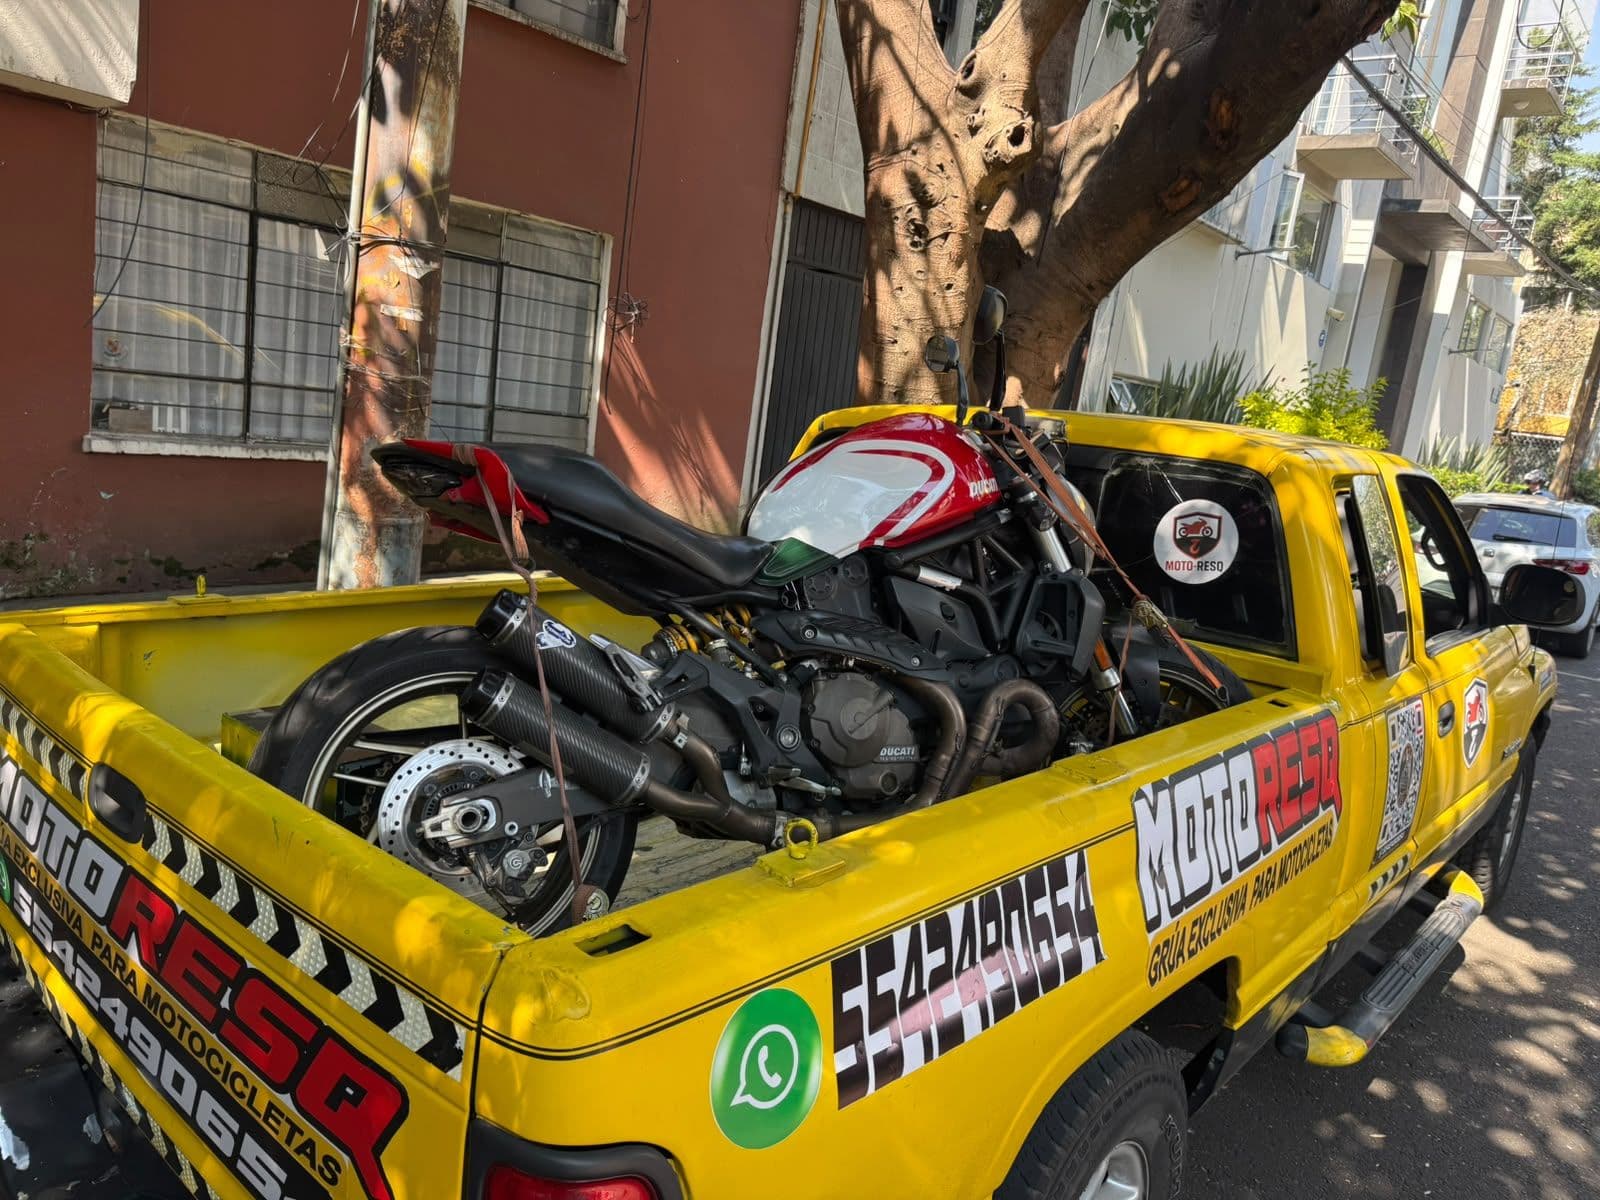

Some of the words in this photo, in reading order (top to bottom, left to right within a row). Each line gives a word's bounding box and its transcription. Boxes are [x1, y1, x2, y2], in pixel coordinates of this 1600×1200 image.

[880, 747, 915, 756] DUCATI
[13, 843, 83, 938] EXCLUSIVA
[91, 930, 138, 996] PARA
[142, 983, 342, 1187] MOTOCICLETAS
[831, 849, 1105, 1110] 5542490654
[1148, 921, 1186, 987] GRÚA
[1188, 882, 1248, 960] EXCLUSIVA
[1249, 862, 1277, 911] PARA
[1276, 817, 1333, 891] MOTOCICLETAS
[13, 877, 297, 1200] 554249065
